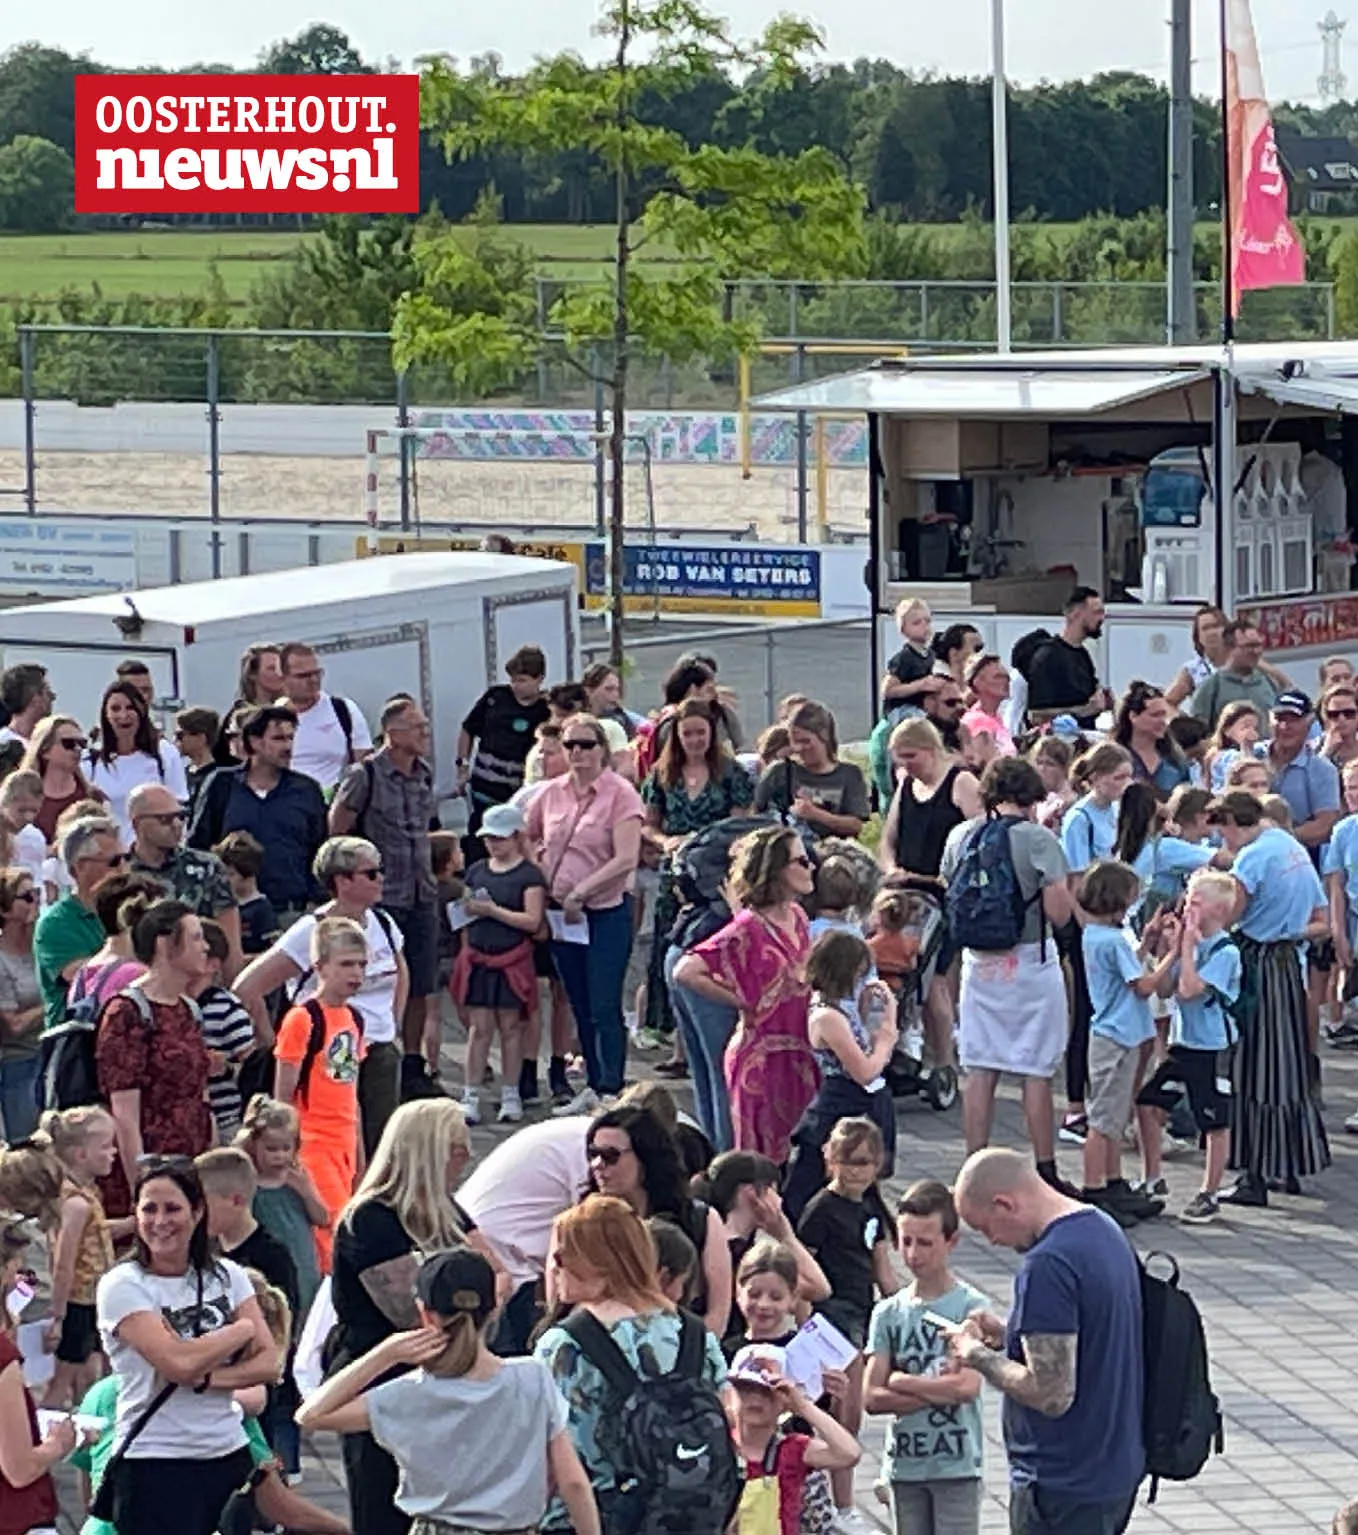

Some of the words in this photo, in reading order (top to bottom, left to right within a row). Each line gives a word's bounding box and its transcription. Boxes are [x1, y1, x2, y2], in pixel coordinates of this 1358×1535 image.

[636, 564, 681, 580] ROB
[685, 565, 726, 582] VAN
[886, 1323, 951, 1353] HAV
[888, 1428, 968, 1459] REAT
